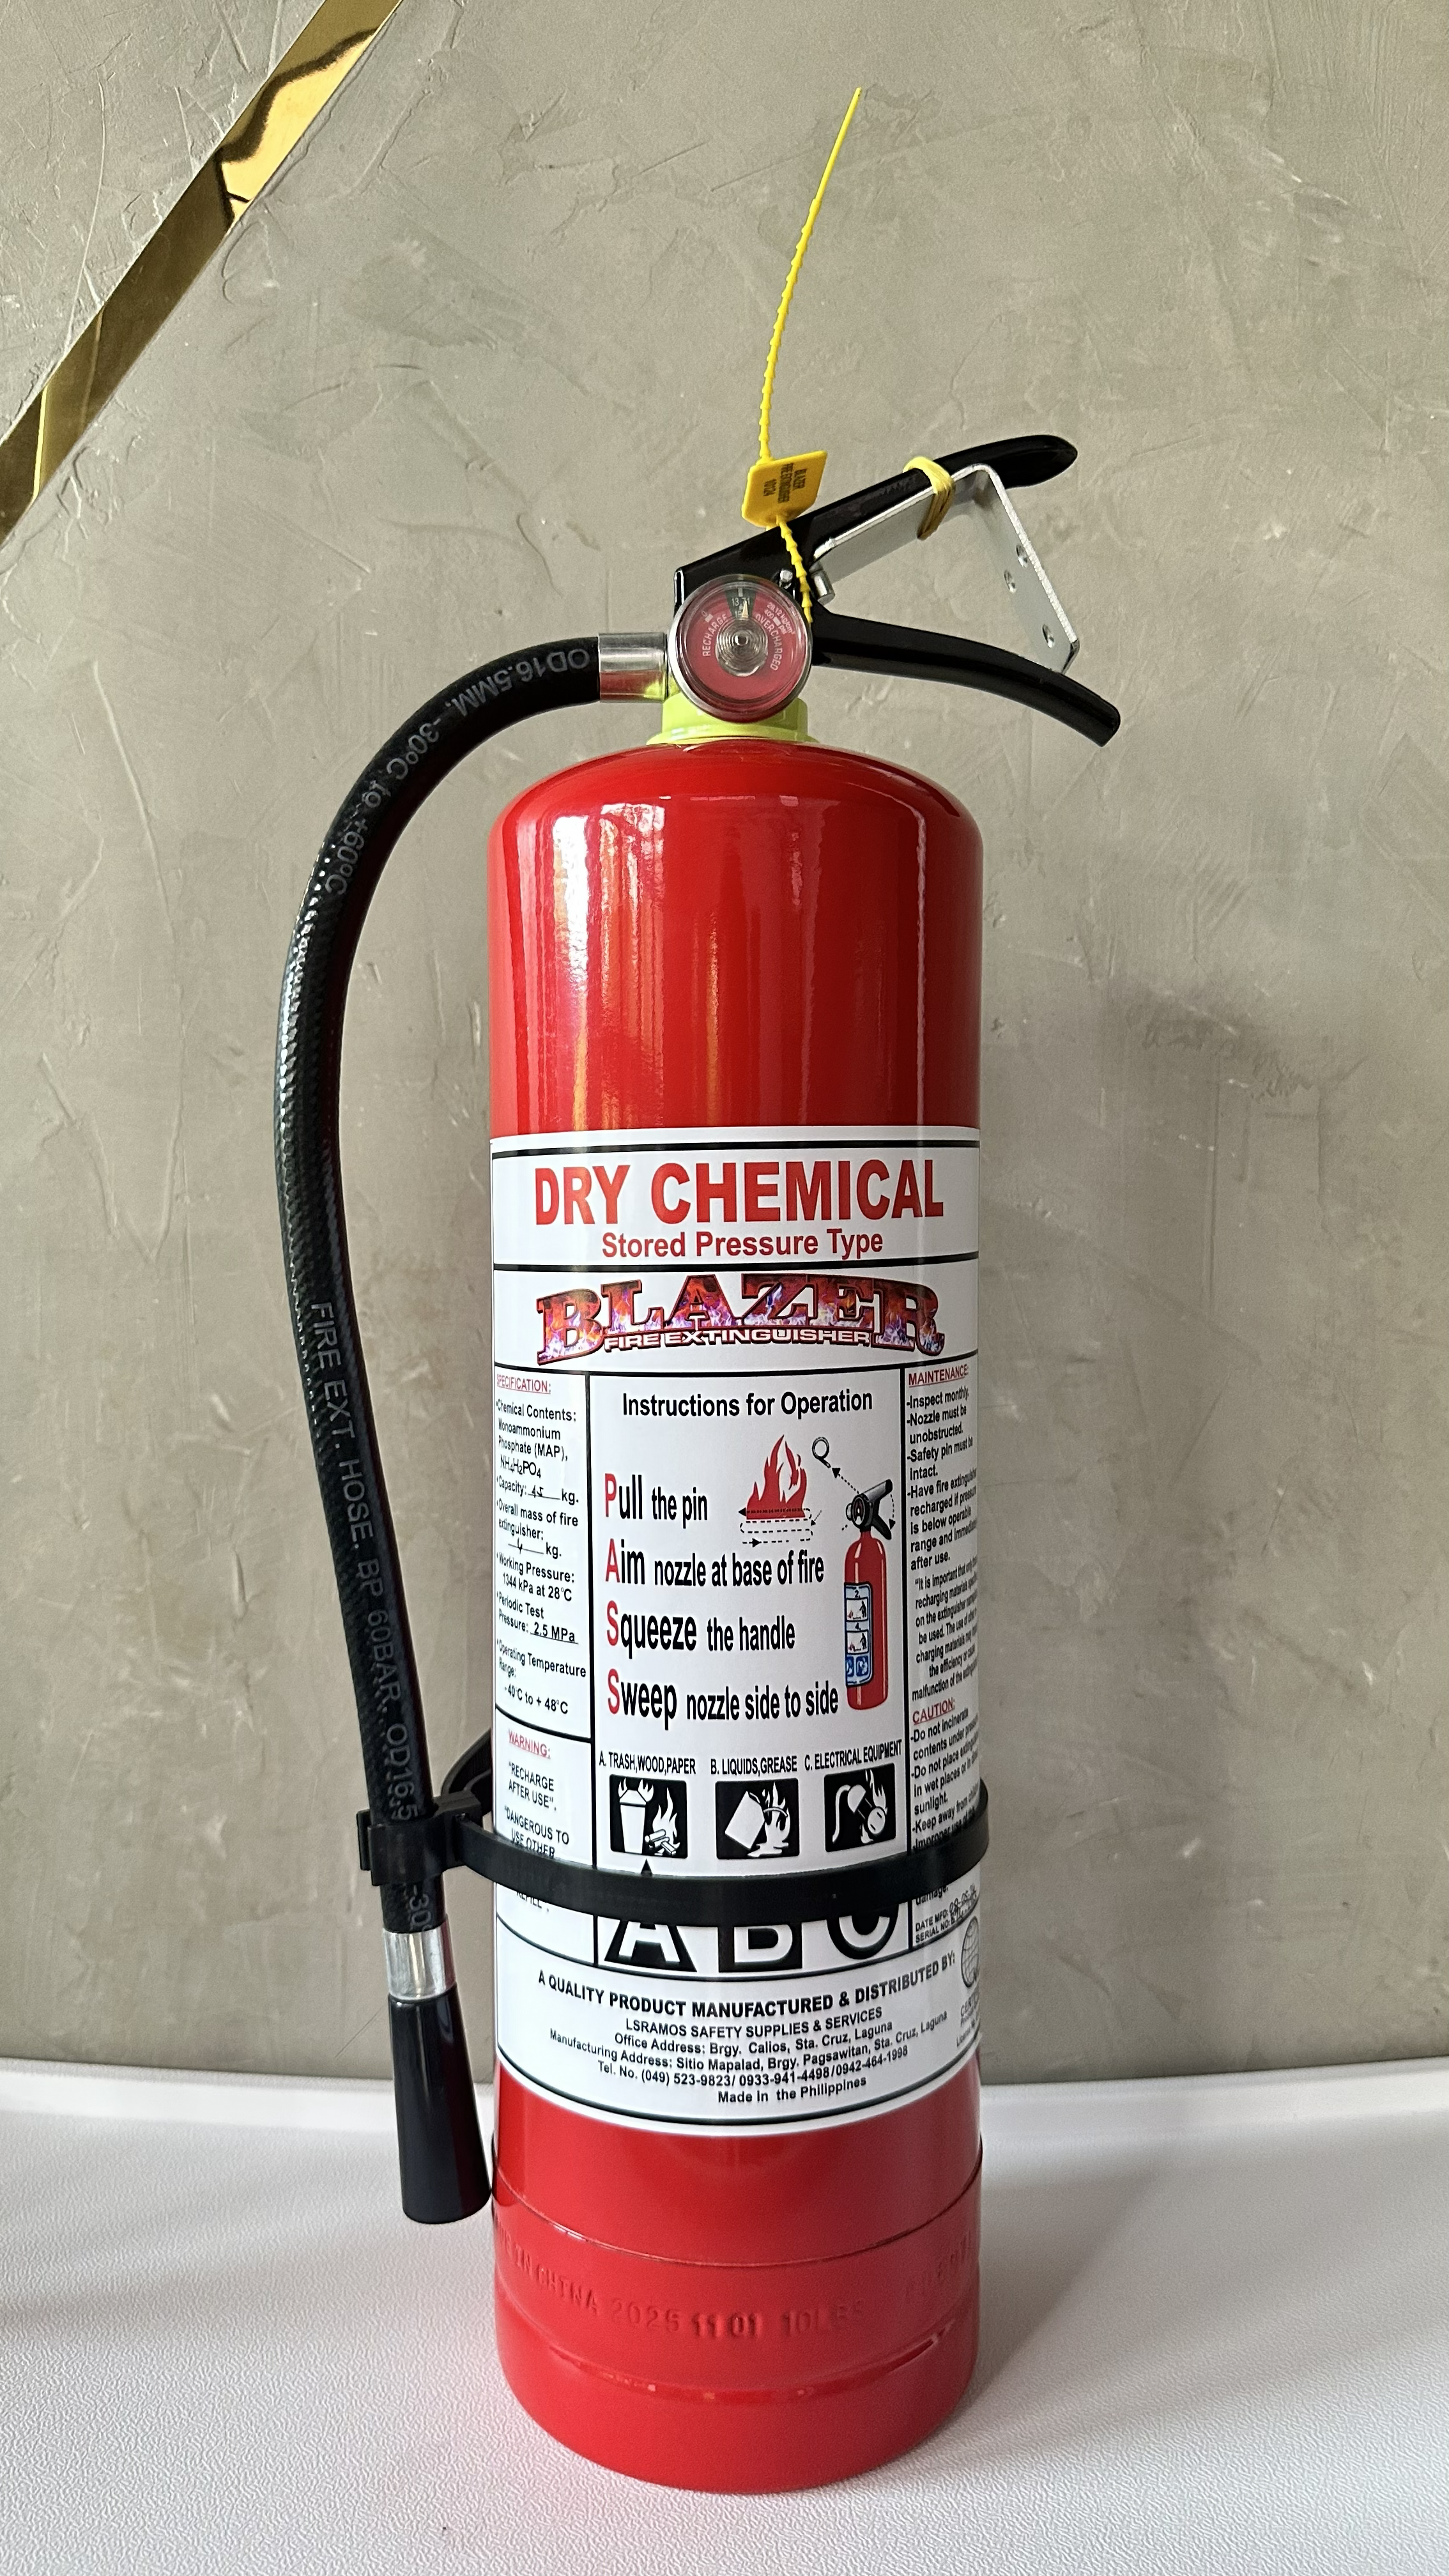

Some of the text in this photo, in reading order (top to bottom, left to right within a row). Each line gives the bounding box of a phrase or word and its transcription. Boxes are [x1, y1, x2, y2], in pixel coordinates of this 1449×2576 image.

[534, 1158, 944, 1227] DRY CHEMICAL
[602, 1228, 883, 1261] Stored Pressure Type
[536, 1273, 945, 1366] BLAZER
[310, 1301, 342, 1369] FIRE
[604, 1315, 871, 1351] FIRE EXTINGUISHER
[323, 1379, 356, 1450] EXT.
[527, 1405, 576, 1422] Contents:
[623, 1390, 872, 1420] Instructions for Operation
[942, 1407, 959, 1422] must
[498, 1418, 560, 1440] Monoammonium
[910, 1422, 963, 1445] unobstructed.
[498, 1435, 568, 1461] Phosphate (MAP),
[940, 1443, 953, 1459] pin
[910, 1464, 938, 1481] intact.
[562, 1489, 579, 1505] kg.
[936, 1480, 949, 1493] fire
[339, 1459, 376, 1549] HOSE.
[604, 1473, 707, 1529] Pull the pin
[910, 1493, 953, 1517] recharged
[521, 1508, 542, 1522] mass
[546, 1511, 556, 1523] of
[560, 1512, 578, 1527] fire
[910, 1521, 919, 1535] is
[921, 1516, 946, 1532] below
[546, 1542, 562, 1559] kg.
[910, 1537, 937, 1552] range
[939, 1528, 953, 1545] and
[526, 1561, 574, 1583] Pressure:
[605, 1538, 824, 1586] Aim nozzle at base of fire
[910, 1551, 950, 1570] after use.
[357, 1558, 384, 1597] BP
[519, 1578, 533, 1594] kPa
[536, 1583, 545, 1598] at
[525, 1602, 544, 1619] Test
[498, 1608, 575, 1643] Pressure: 2.5 MPa
[607, 1600, 795, 1659] Squeeze the handle
[528, 1652, 586, 1678] Temperature
[525, 1692, 533, 1705] to
[608, 1668, 839, 1731] Sweep nozzle side to side
[912, 1698, 955, 1725] CAUTION:
[928, 1724, 940, 1738] not
[508, 1729, 550, 1758] WARNING:
[804, 1739, 902, 1772] C. ELECTRICAL EQUIPMENT
[913, 1737, 947, 1761] contents
[599, 1751, 607, 1767] A.
[710, 1761, 719, 1775] B.
[508, 1779, 530, 1801] AFTER
[914, 1791, 948, 1816] sunlight.
[556, 1829, 570, 1845] TO
[916, 1916, 933, 1932] DATE
[916, 1926, 939, 1943] SERIAL
[538, 1949, 956, 2018] A QUALITY PRODUCT MANUFACTURED & DISTRIBUTED BY:
[625, 2006, 882, 2038] LSRAMOS SAFETY SUPPLIES & SERVICES
[549, 2028, 618, 2062] Manufacturing
[620, 2050, 672, 2068] Address:
[676, 2056, 704, 2070] Sitio
[709, 2058, 763, 2073] Mapalad,
[767, 2052, 799, 2070] Brgy.
[803, 2043, 871, 2067] Pagsawitan,
[874, 2036, 893, 2051] Sta.
[896, 2026, 919, 2044] Cruz,
[921, 2011, 947, 2034] Laguna
[615, 2020, 893, 2058] Office Address: Brgy. Calios, Sta. Cruz, Laguna
[598, 2060, 616, 2075] Tel.
[619, 2066, 638, 2079] No.
[641, 2069, 670, 2086] (049)
[717, 2090, 753, 2103] Made
[776, 2088, 796, 2101] the
[801, 2077, 866, 2097] Philippines
